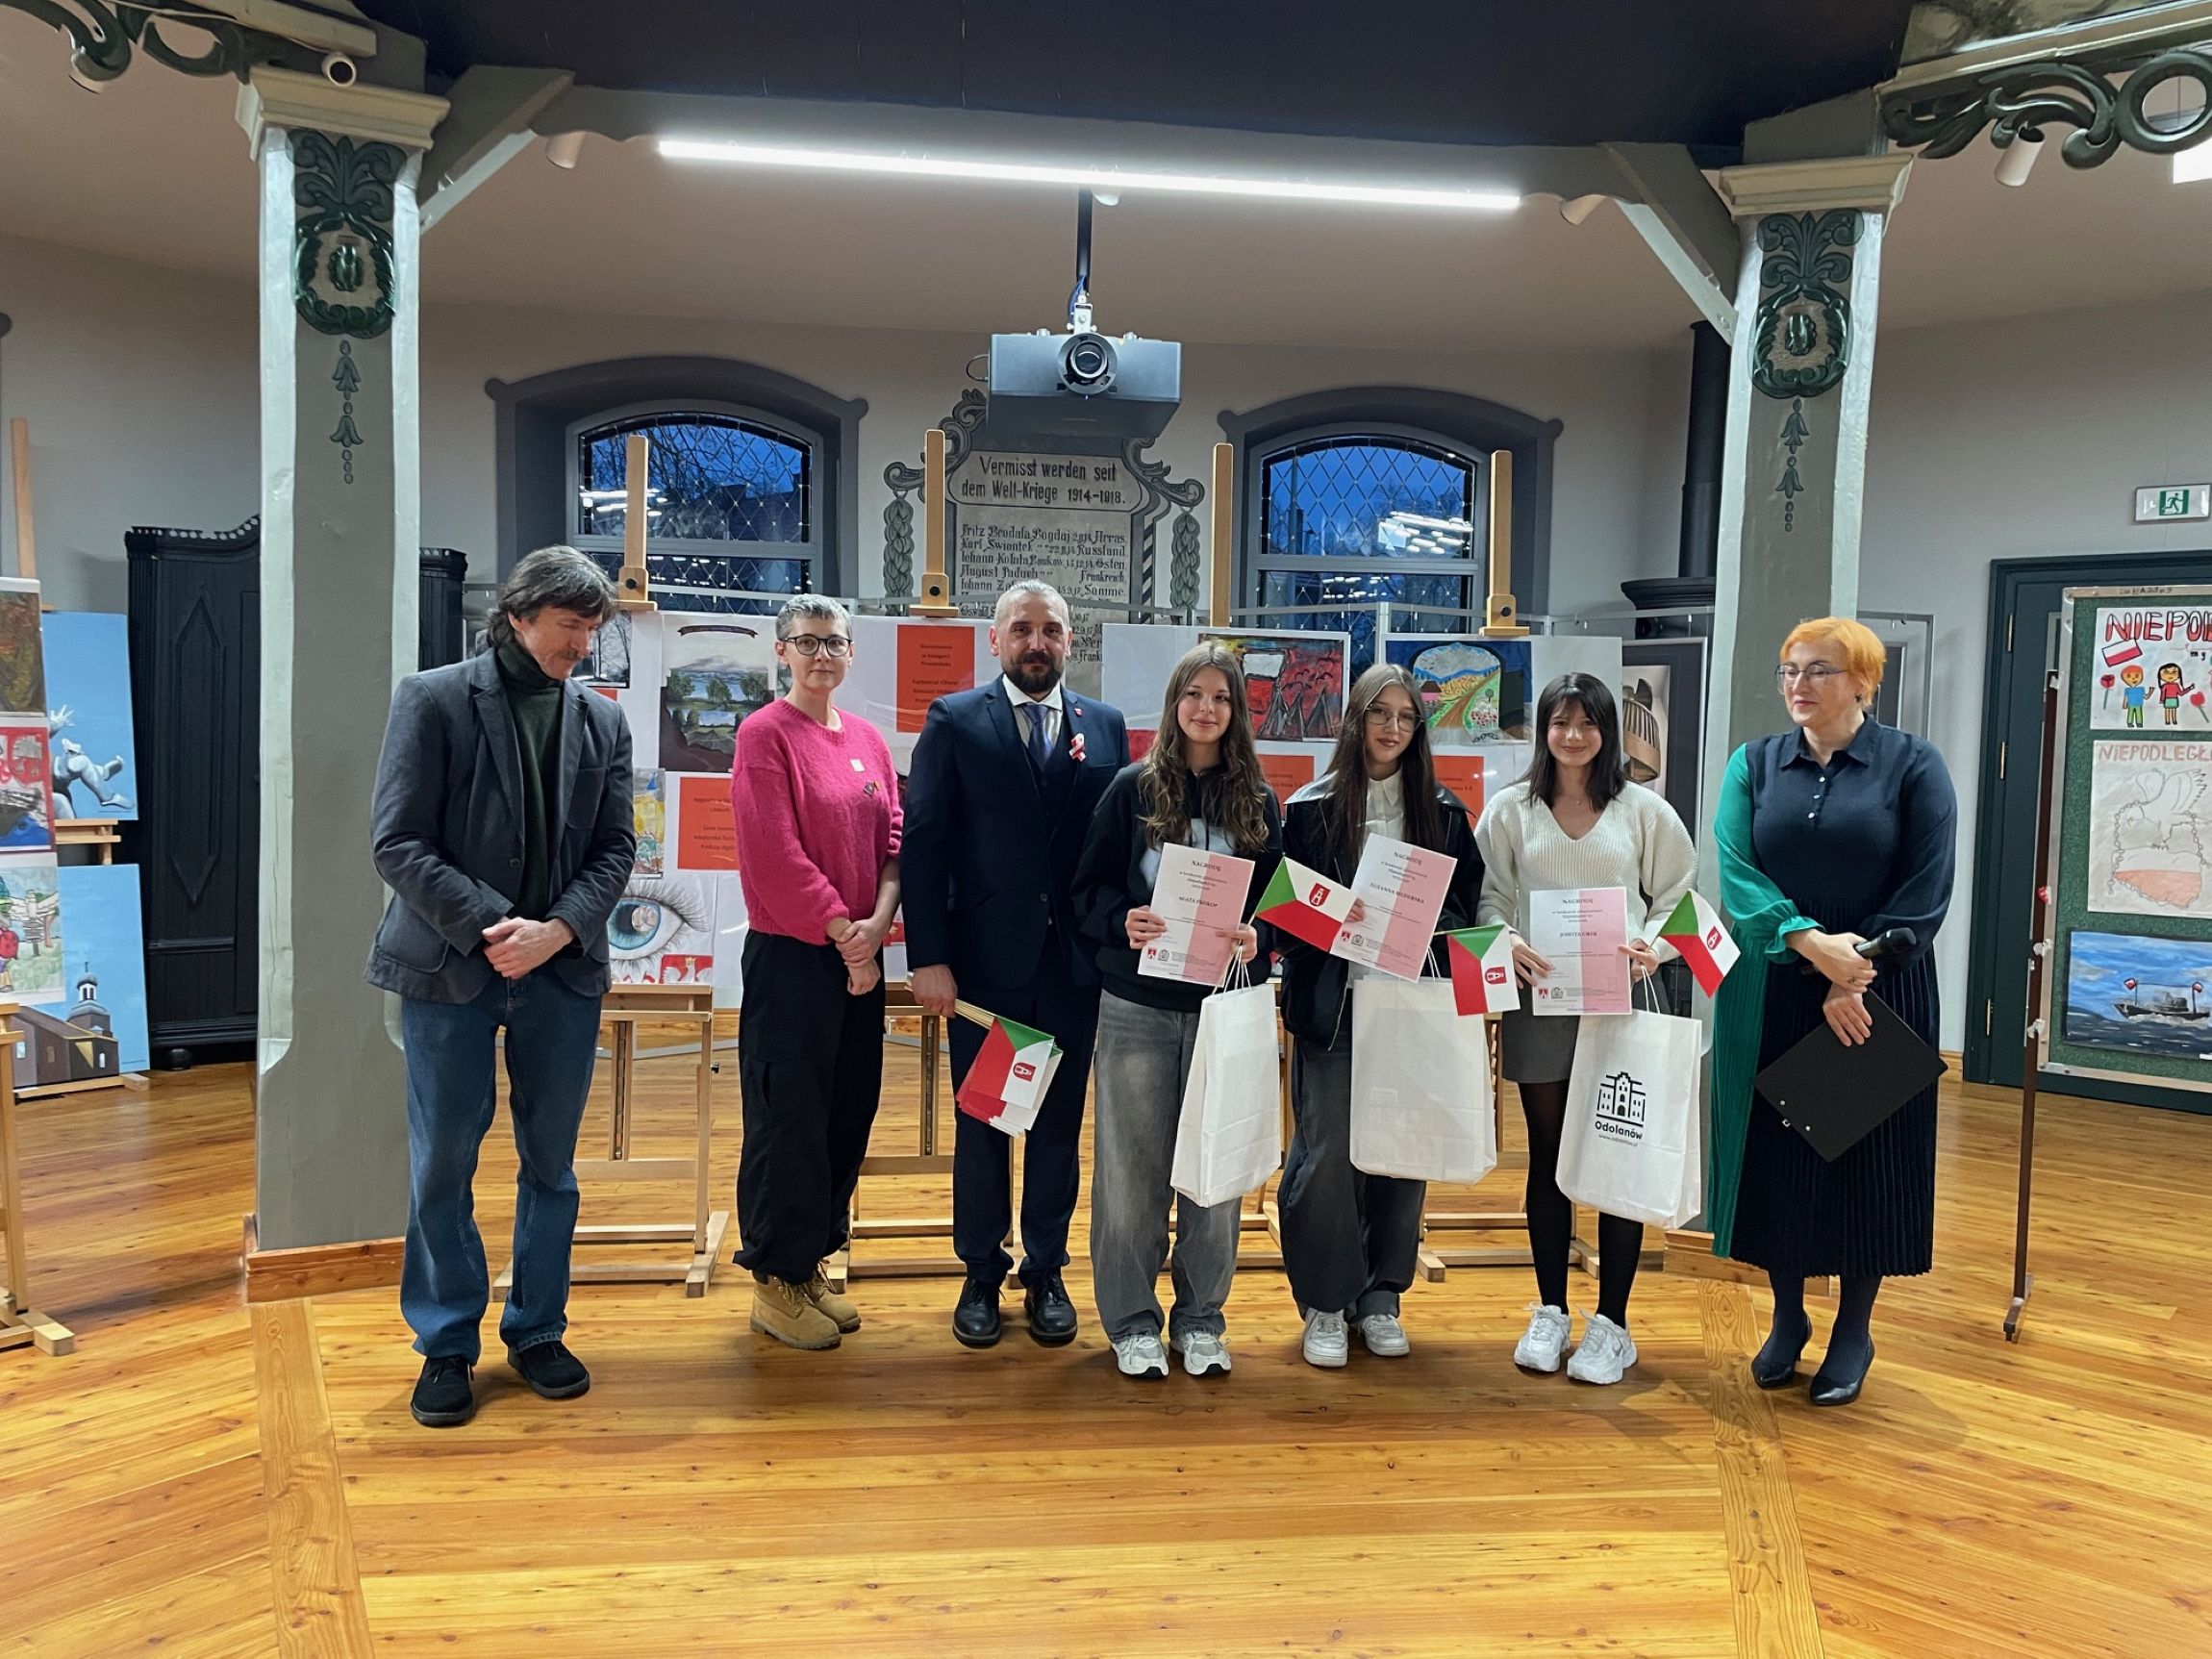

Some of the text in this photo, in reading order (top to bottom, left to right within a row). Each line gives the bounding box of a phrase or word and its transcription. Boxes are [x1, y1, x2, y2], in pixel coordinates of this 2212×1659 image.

[979, 456, 1118, 482] Vermisst werden seit
[962, 479, 986, 497] dem
[993, 480, 1058, 505] Welt-Kriege
[960, 524, 985, 538] Fritz
[1595, 1119, 1644, 1140] Odolanów
